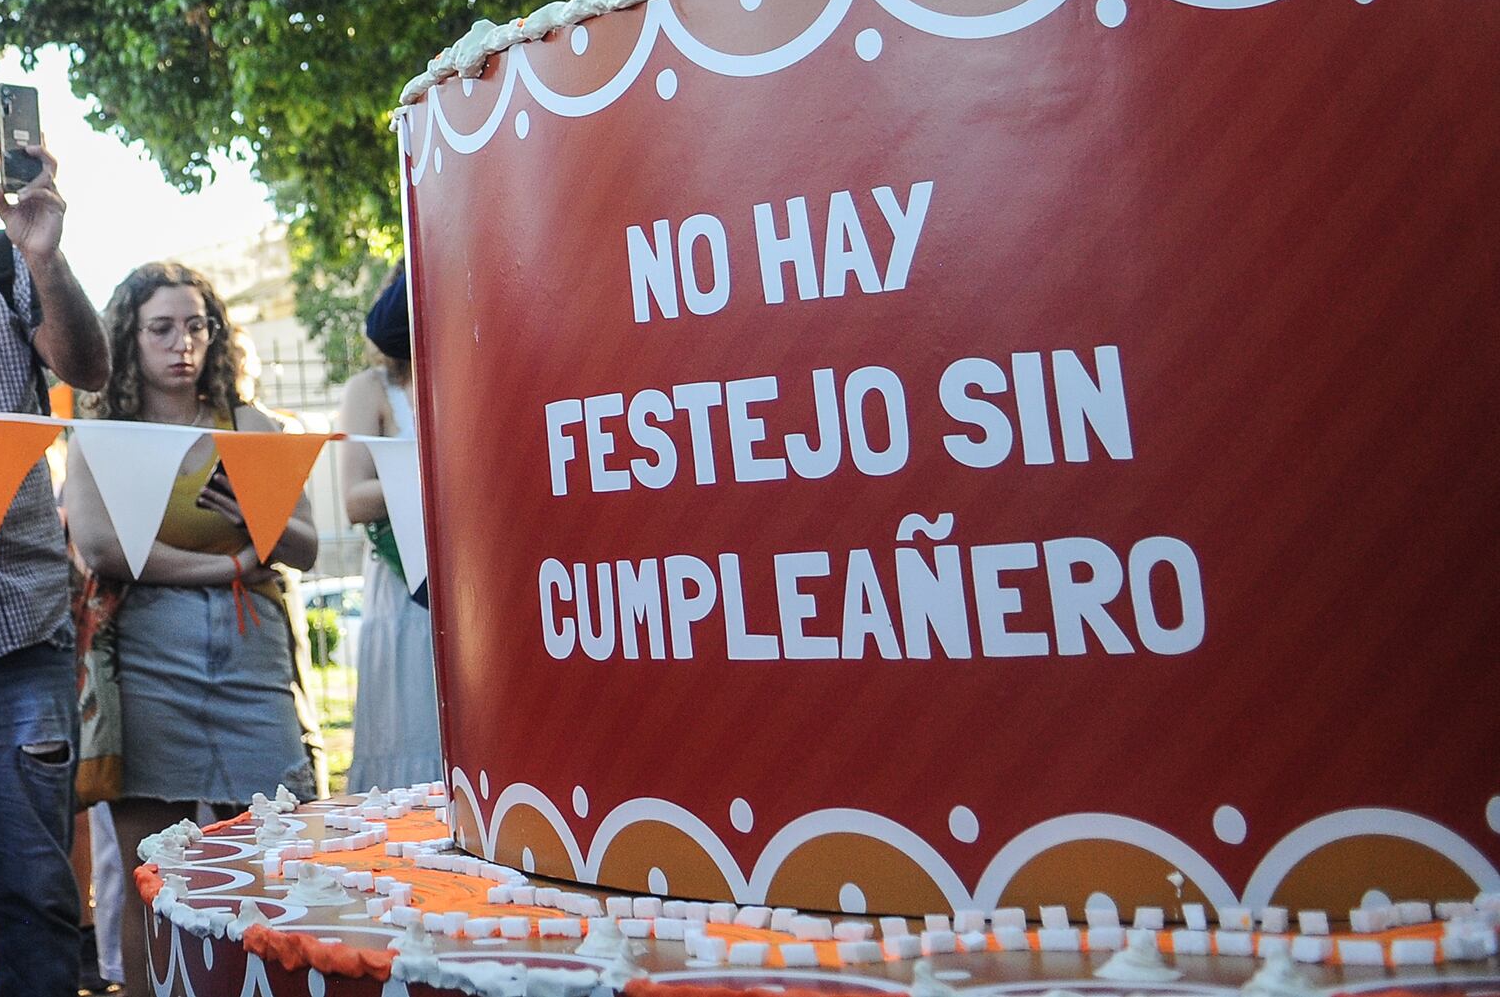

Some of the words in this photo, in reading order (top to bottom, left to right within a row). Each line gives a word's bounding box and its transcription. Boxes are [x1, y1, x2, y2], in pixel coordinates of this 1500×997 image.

[626, 214, 731, 323] NO
[753, 180, 934, 305] HAY
[545, 365, 910, 497] FESTEJO
[938, 345, 1134, 469] SIN
[538, 512, 1206, 661] CUMPLEAÑERO
